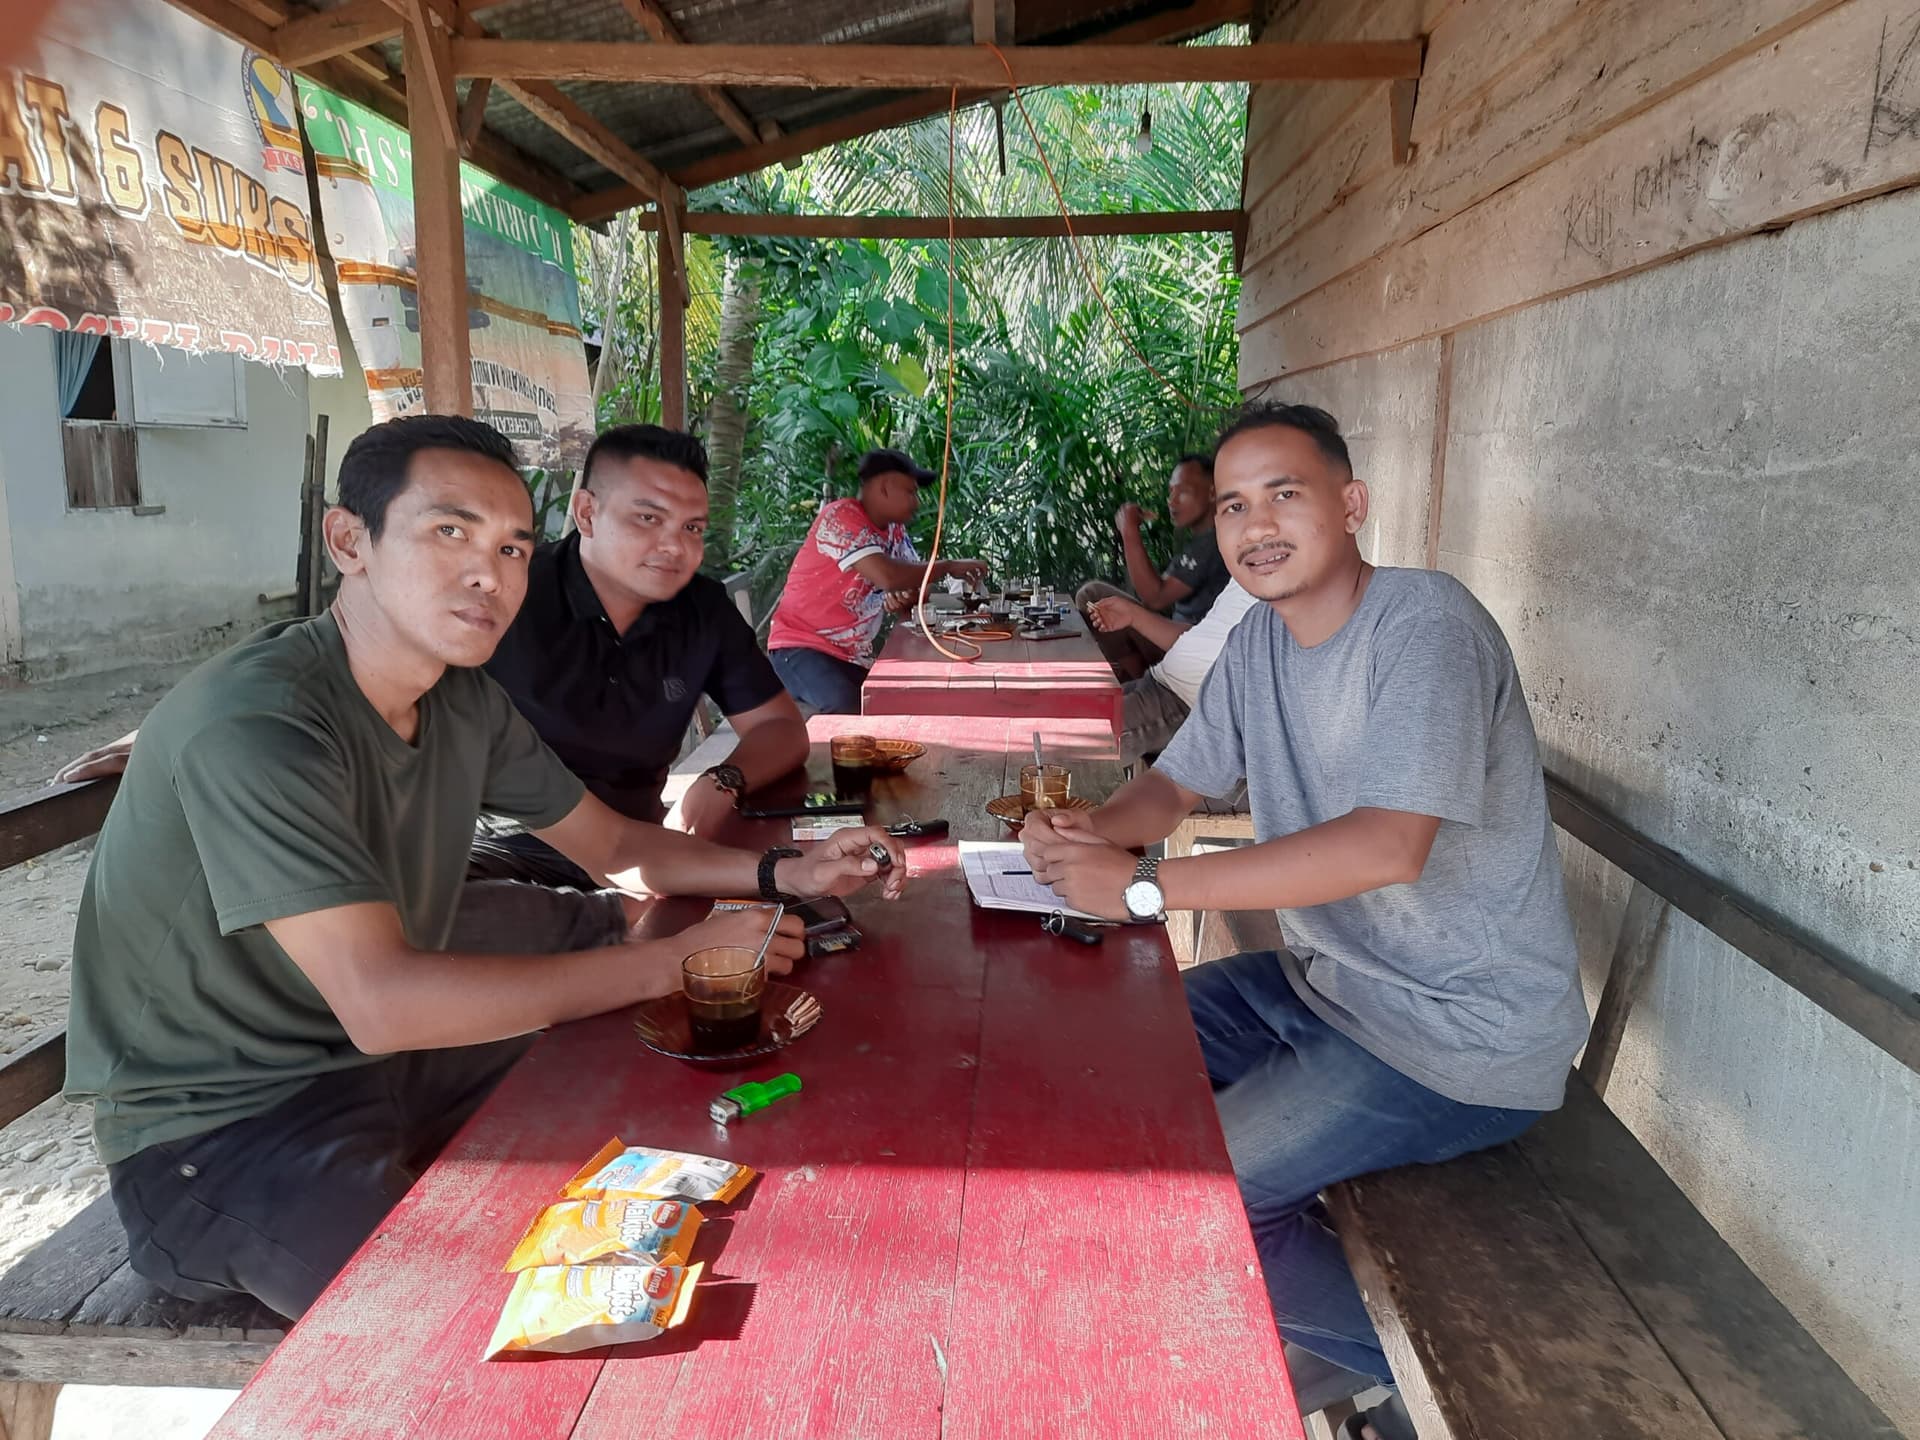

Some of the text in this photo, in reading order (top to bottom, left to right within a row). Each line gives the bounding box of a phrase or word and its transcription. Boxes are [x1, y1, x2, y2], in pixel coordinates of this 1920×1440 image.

[95, 101, 150, 221] 6
[155, 128, 327, 305] SUKS
[647, 1267, 668, 1294] Roma
